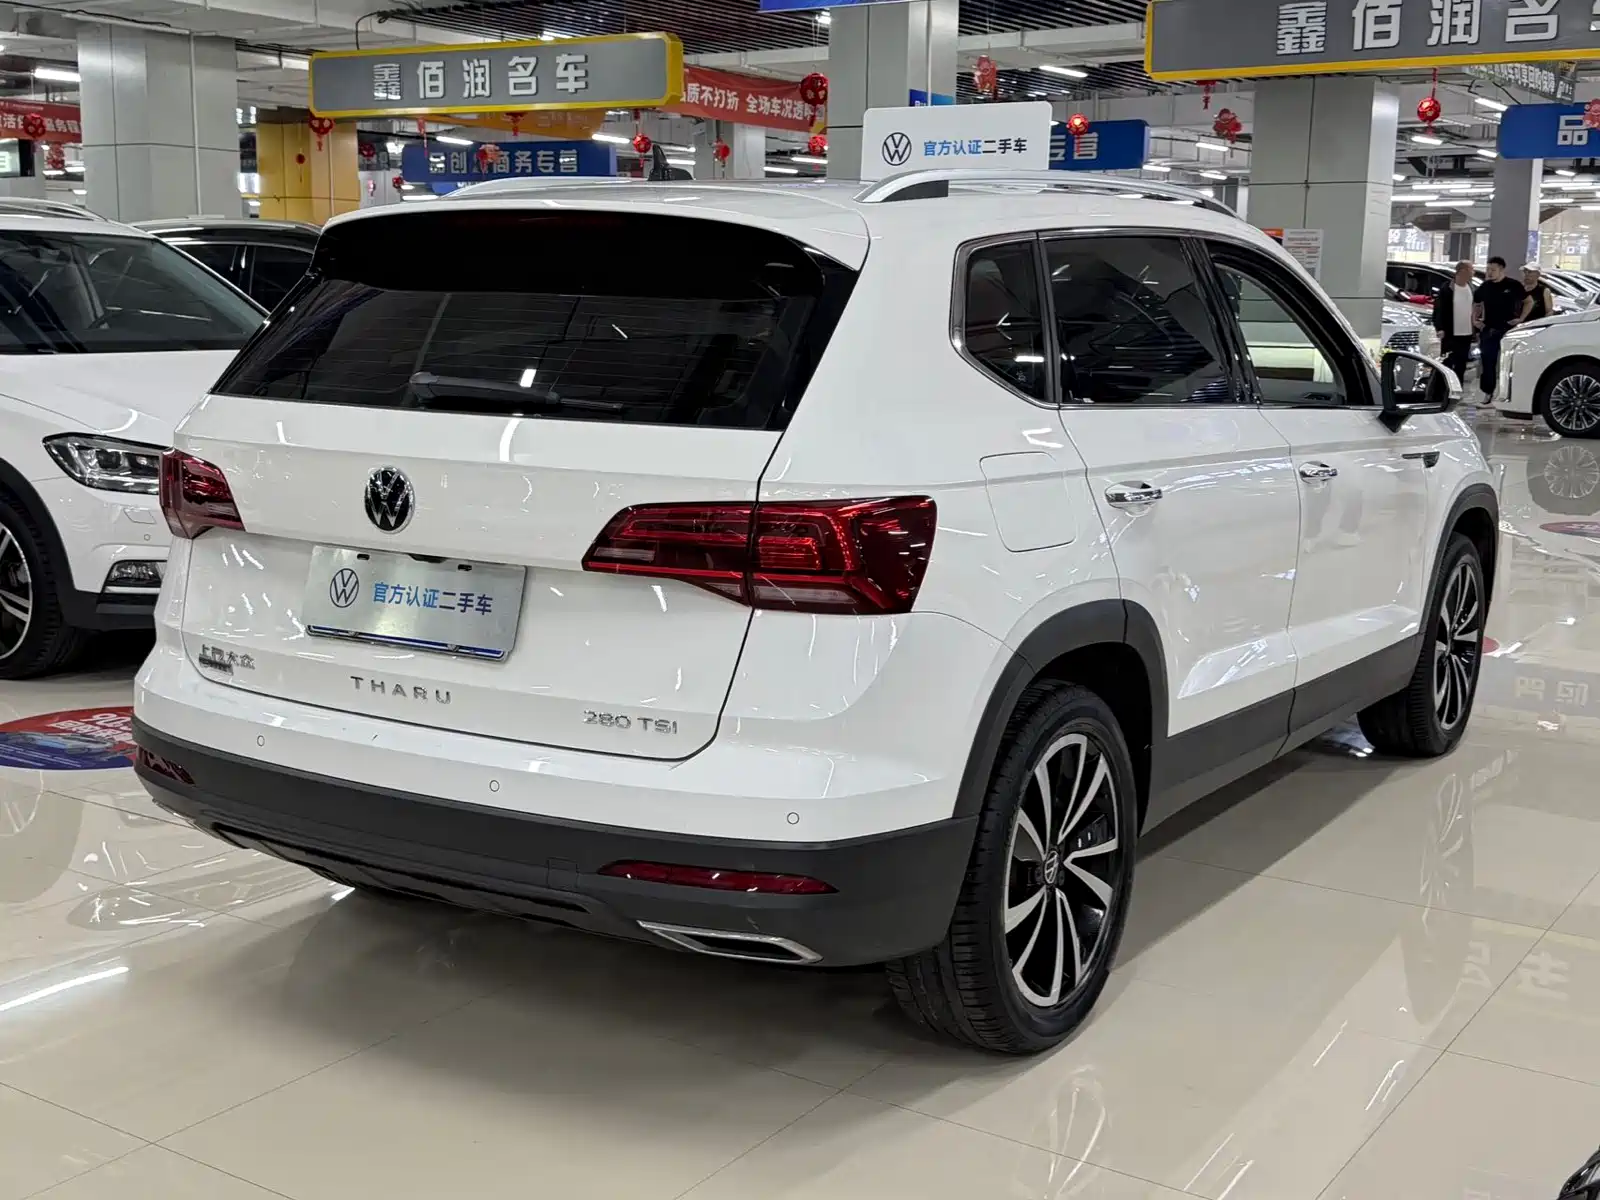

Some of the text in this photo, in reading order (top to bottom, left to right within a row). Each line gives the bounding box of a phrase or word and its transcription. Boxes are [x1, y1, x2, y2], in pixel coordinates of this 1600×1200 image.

[1275, 0, 1600, 56] 鑫佰润名
[373, 53, 589, 101] 鑫佰润名车
[681, 82, 740, 112] 质不打折
[1557, 114, 1589, 146] 品
[429, 149, 579, 174] 品创商务专营
[923, 138, 1028, 157] 官方认证二手车
[373, 581, 493, 616] 官方认证二手车
[350, 675, 452, 705] THARU
[583, 709, 678, 735] 280 TSI
